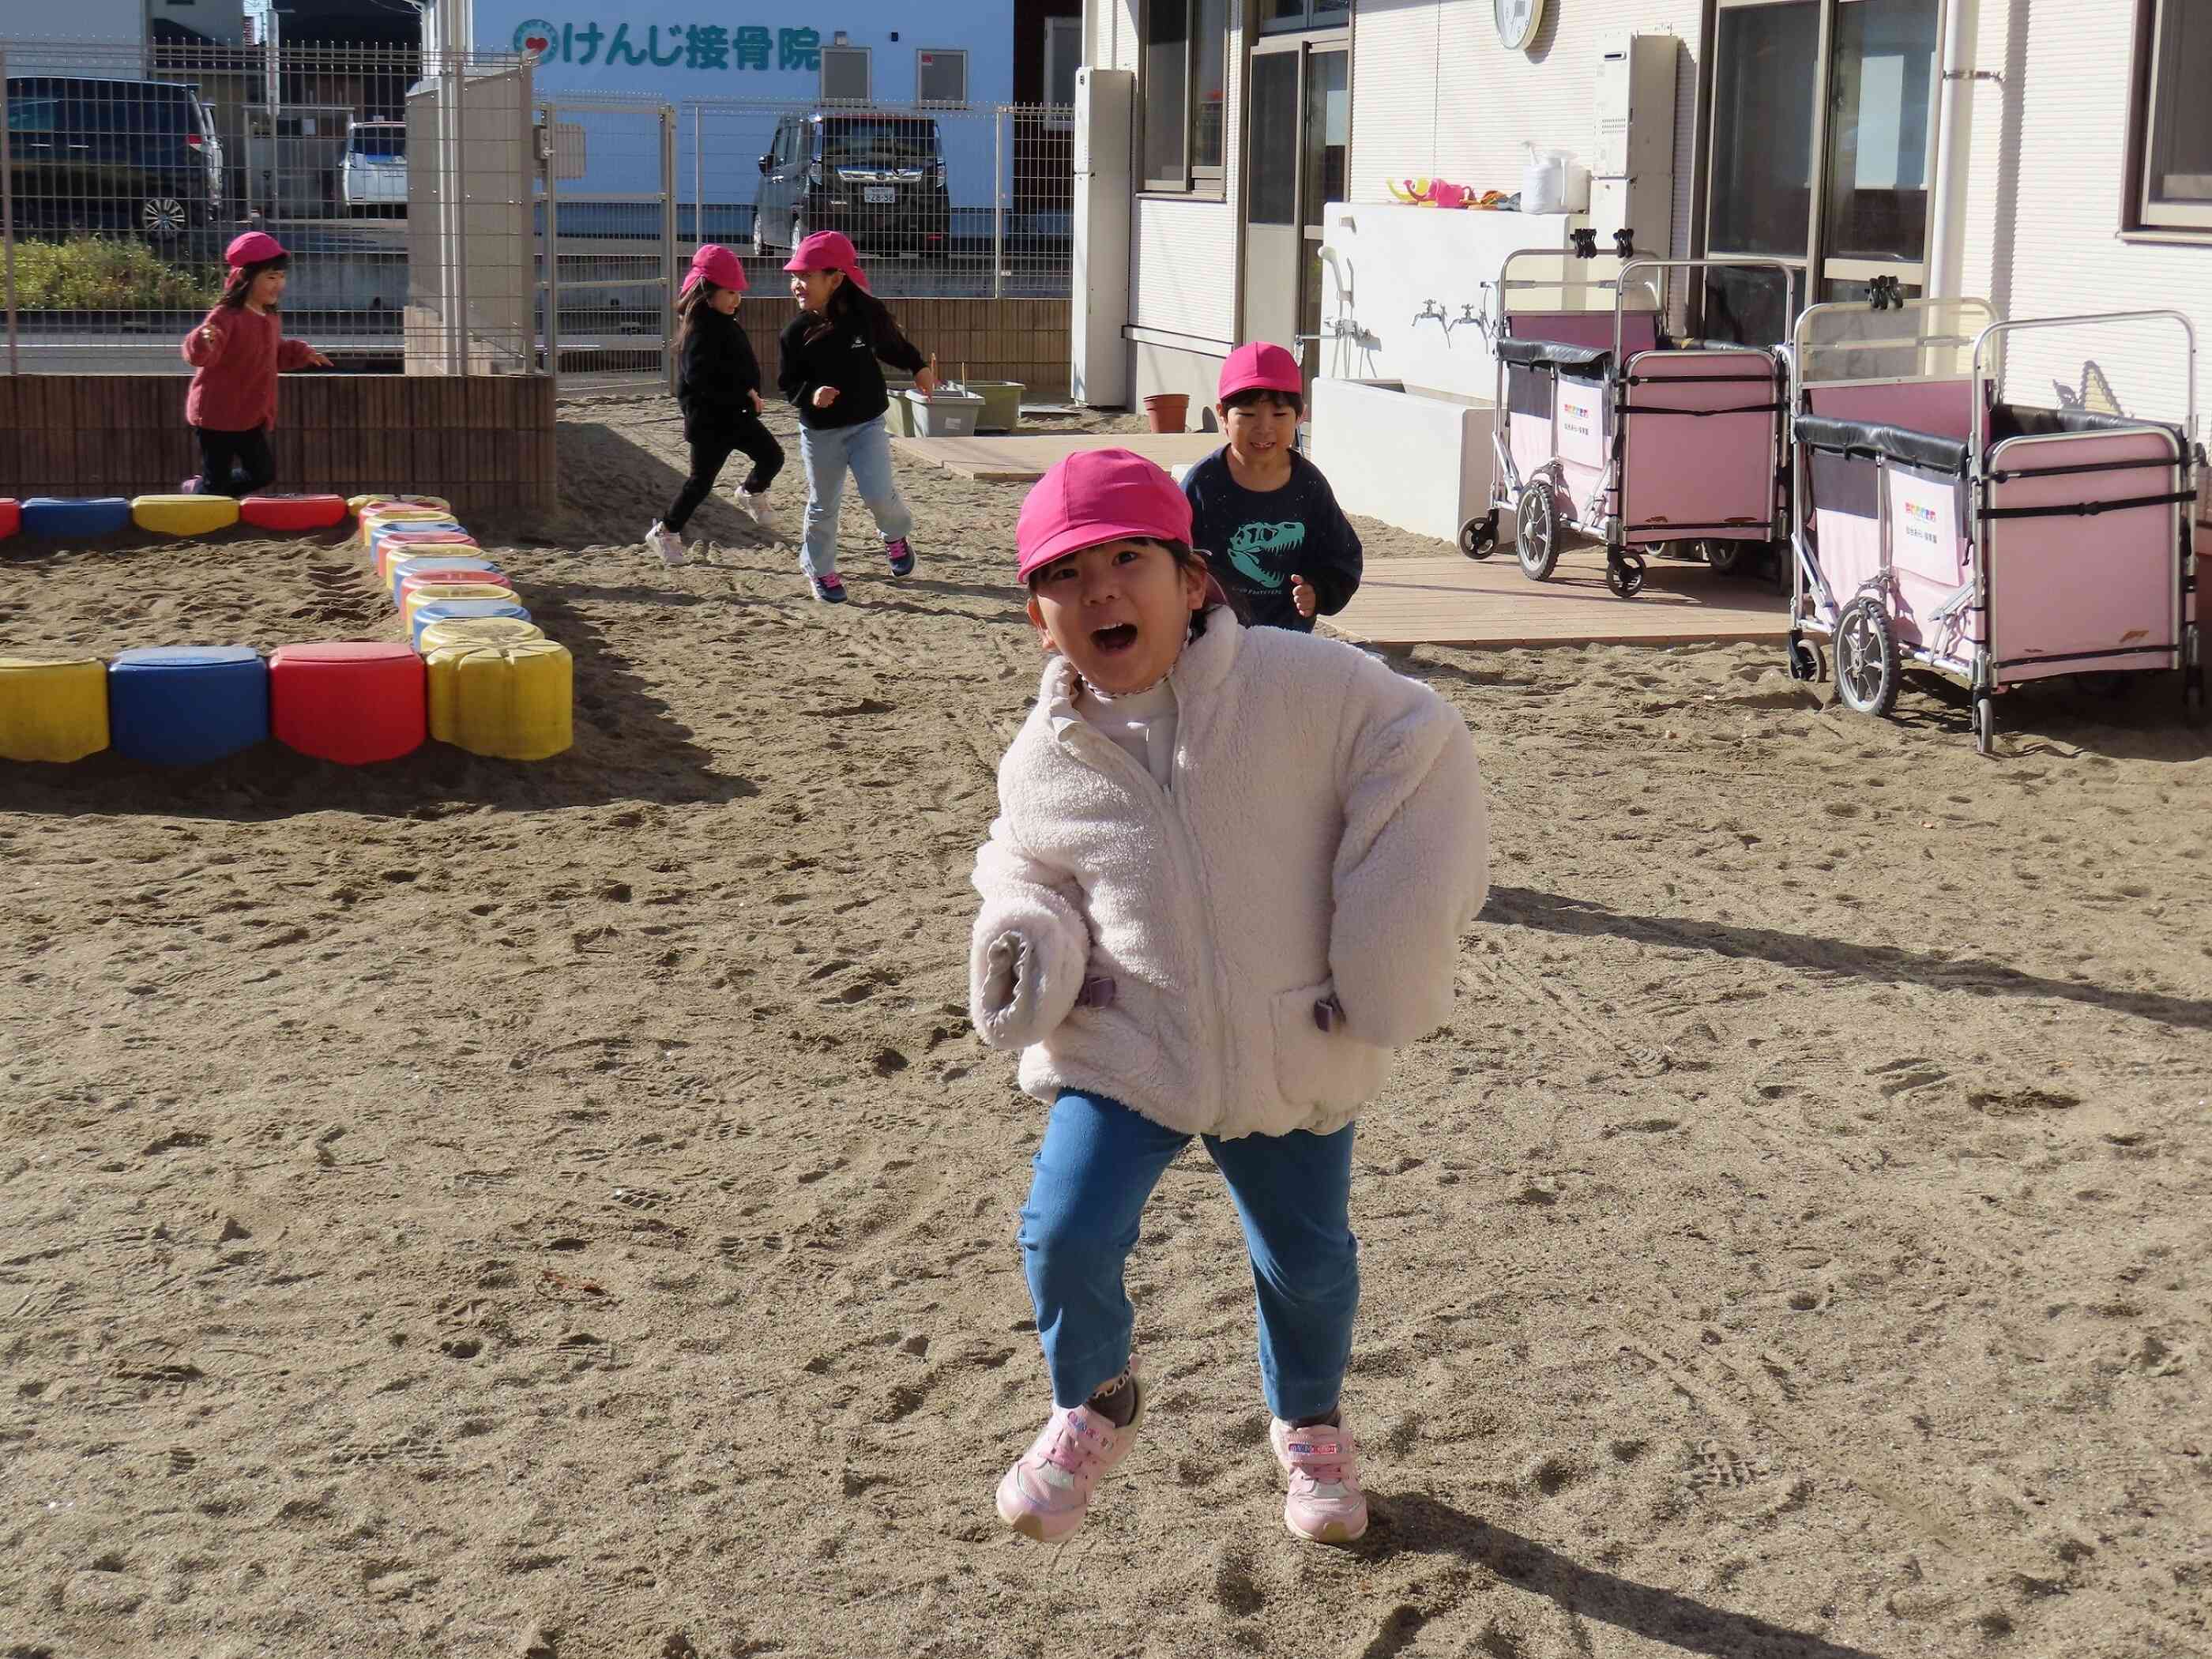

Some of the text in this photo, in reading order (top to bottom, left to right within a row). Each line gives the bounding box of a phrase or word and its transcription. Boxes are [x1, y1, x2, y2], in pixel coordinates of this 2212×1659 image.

[562, 21, 822, 71] けんじ接骨院
